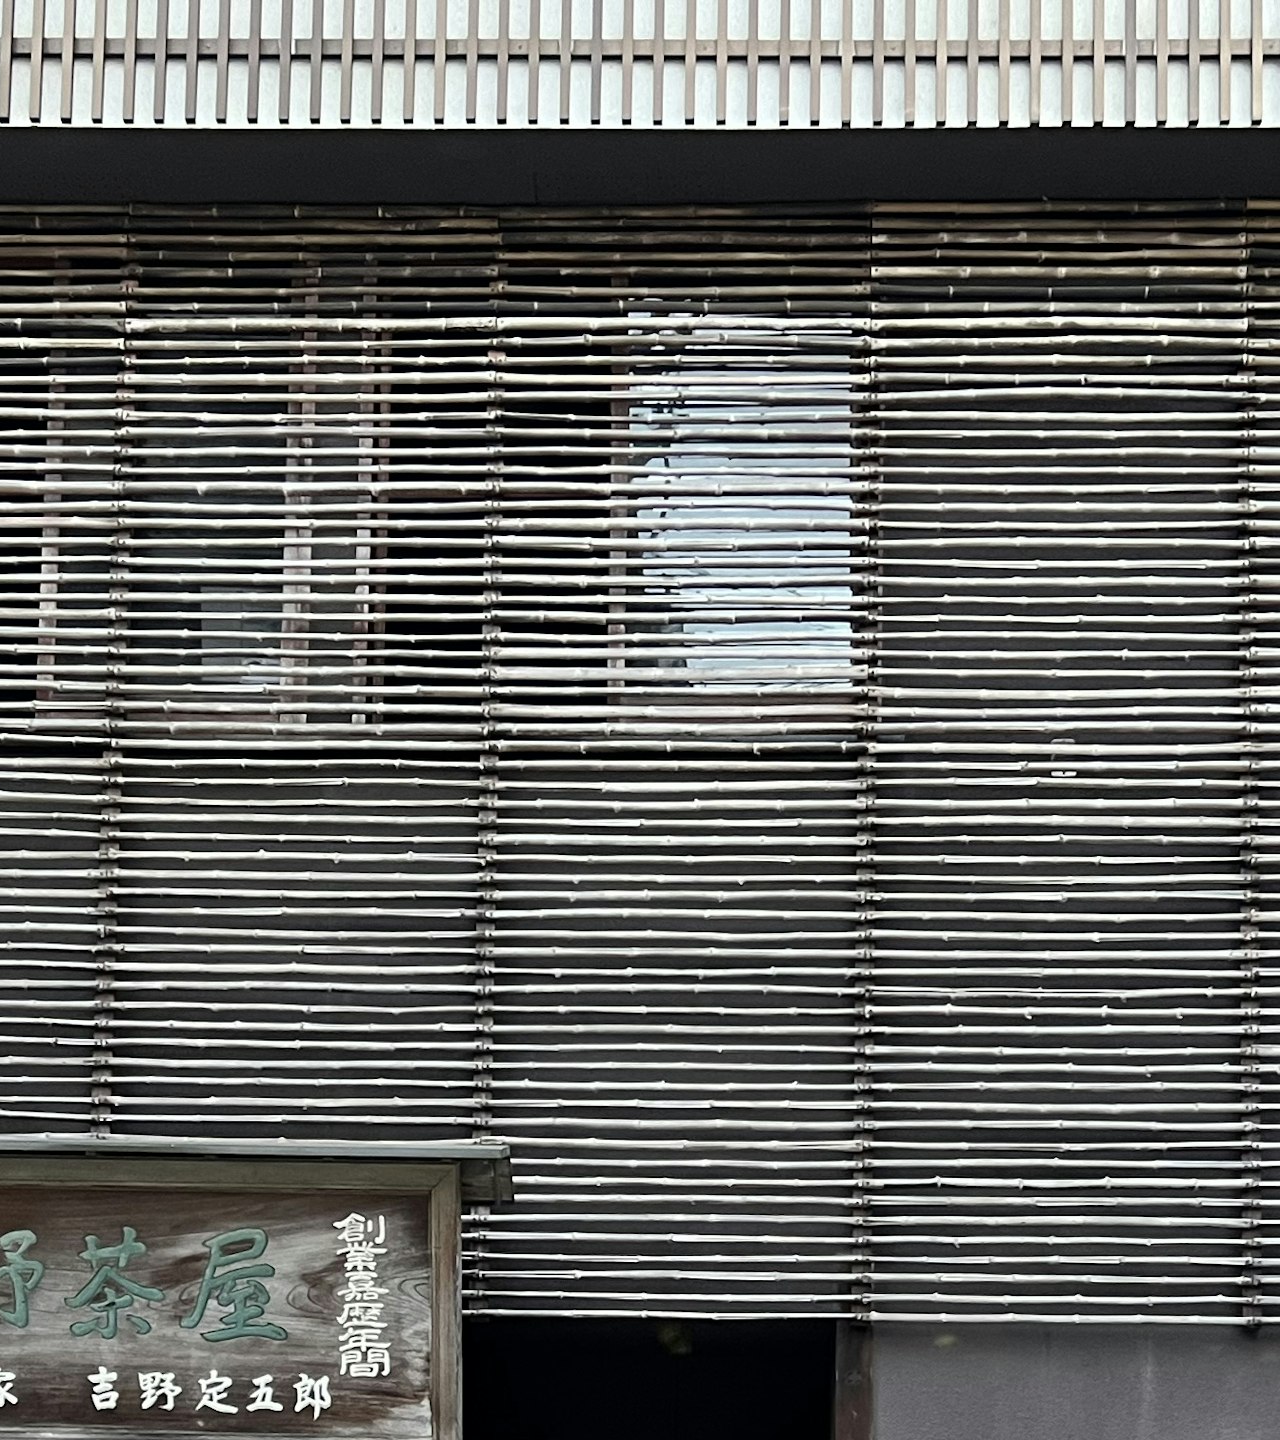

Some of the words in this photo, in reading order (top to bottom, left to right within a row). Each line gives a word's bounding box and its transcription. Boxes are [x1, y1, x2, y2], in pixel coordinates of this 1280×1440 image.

[86, 1369, 333, 1420] 吉野定五郎
